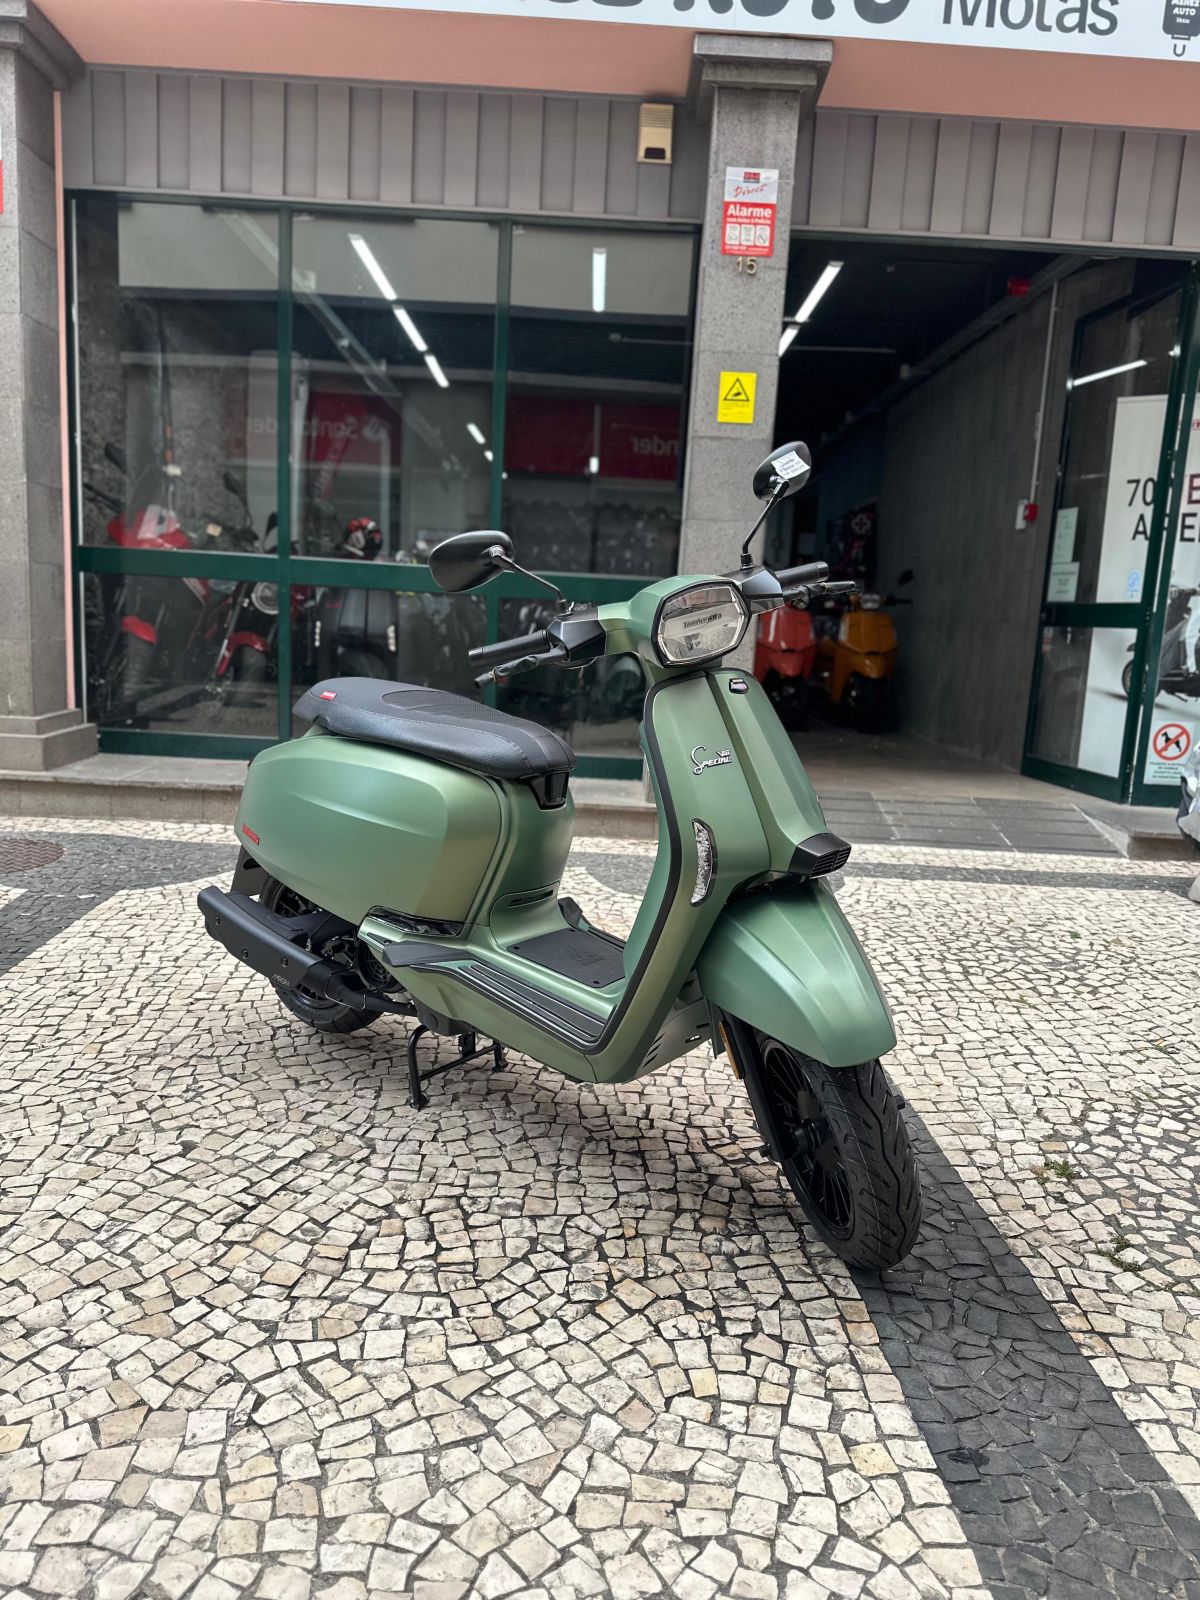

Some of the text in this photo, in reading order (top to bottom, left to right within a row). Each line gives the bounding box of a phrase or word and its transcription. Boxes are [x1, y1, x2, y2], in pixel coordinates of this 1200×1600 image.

[1172, 7, 1197, 16] AUTO
[727, 203, 773, 218] Alarme
[737, 256, 757, 275] 15
